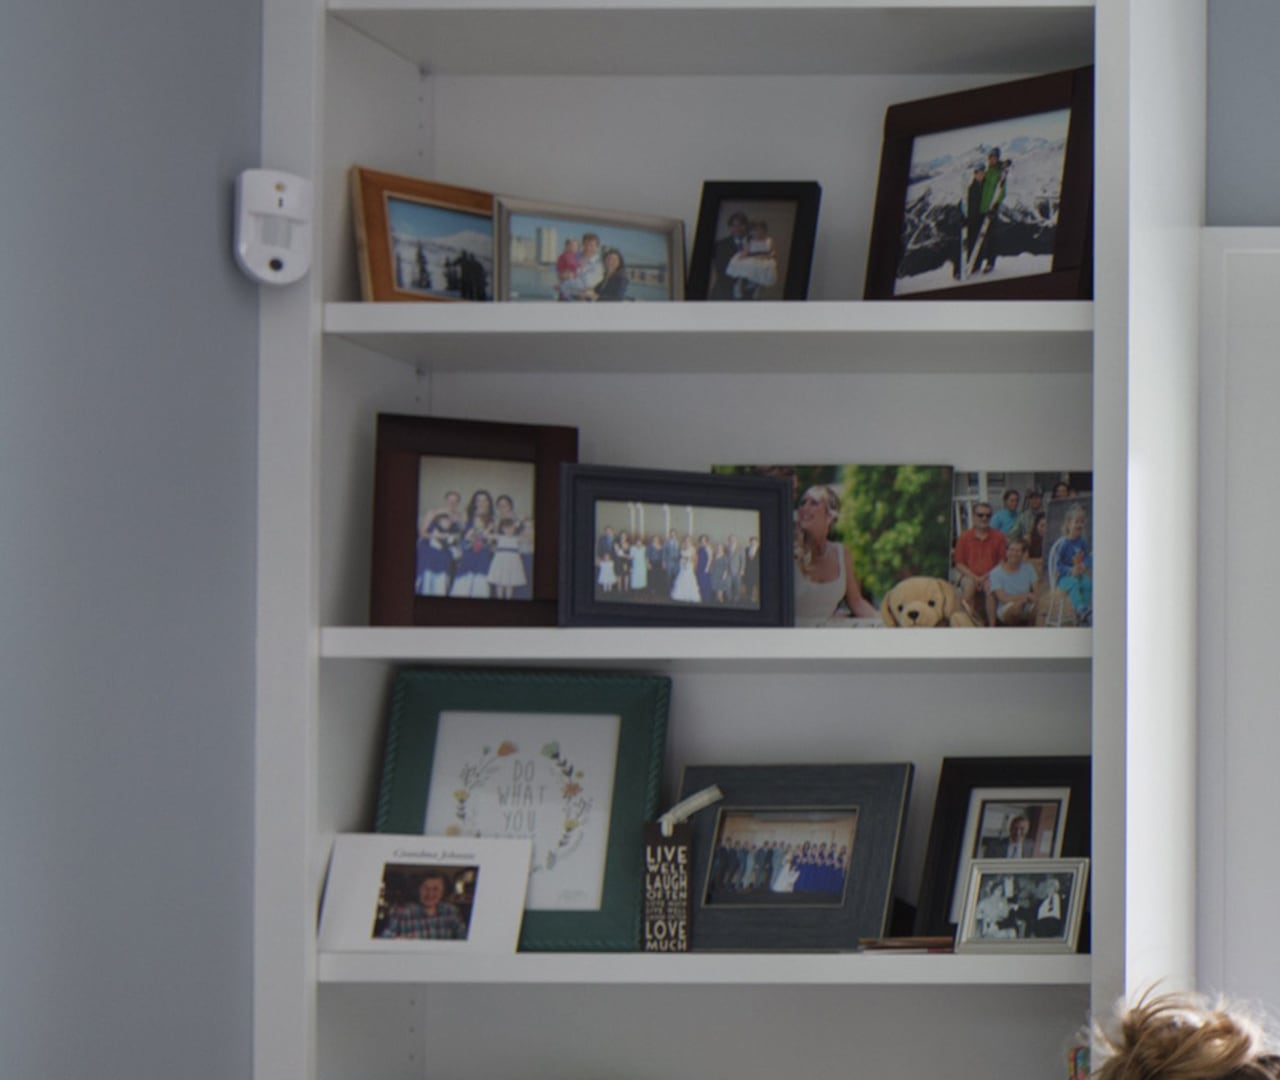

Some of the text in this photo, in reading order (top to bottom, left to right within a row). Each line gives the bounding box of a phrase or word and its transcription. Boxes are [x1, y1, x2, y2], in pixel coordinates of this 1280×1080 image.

[512, 759, 536, 783] DO
[497, 783, 546, 807] WHAT
[503, 810, 537, 832] YOU
[645, 845, 689, 864] LIVE
[646, 863, 688, 874] WELL
[645, 873, 689, 891] LAUGH
[646, 889, 688, 900] OFTEN
[645, 919, 689, 940] LOVE
[645, 940, 688, 951] MUCH
